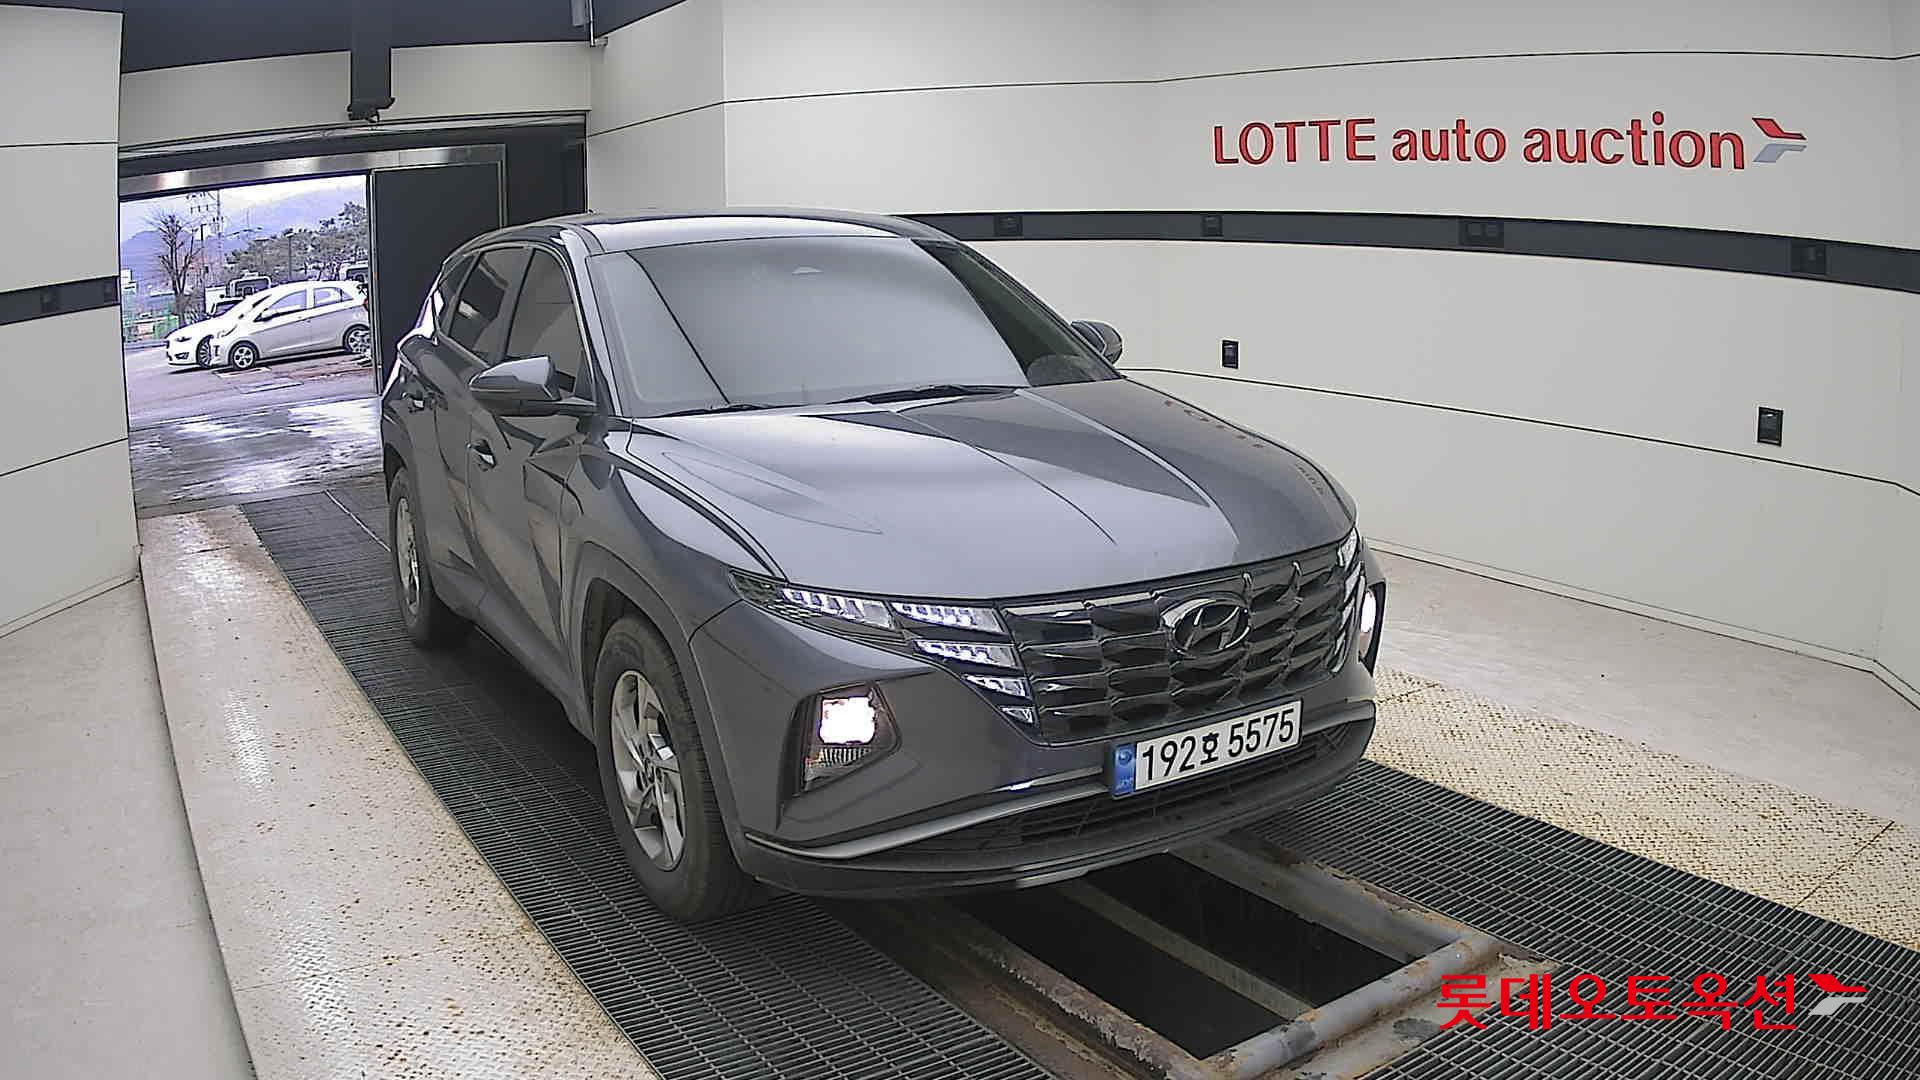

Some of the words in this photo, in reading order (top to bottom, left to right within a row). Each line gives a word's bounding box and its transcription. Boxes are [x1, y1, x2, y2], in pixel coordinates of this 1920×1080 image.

[1213, 118, 1377, 165] LOTTE
[1391, 118, 1508, 164] auto
[1522, 110, 1745, 170] auction
[1142, 732, 1220, 781] 192호
[1228, 708, 1295, 758] 5575
